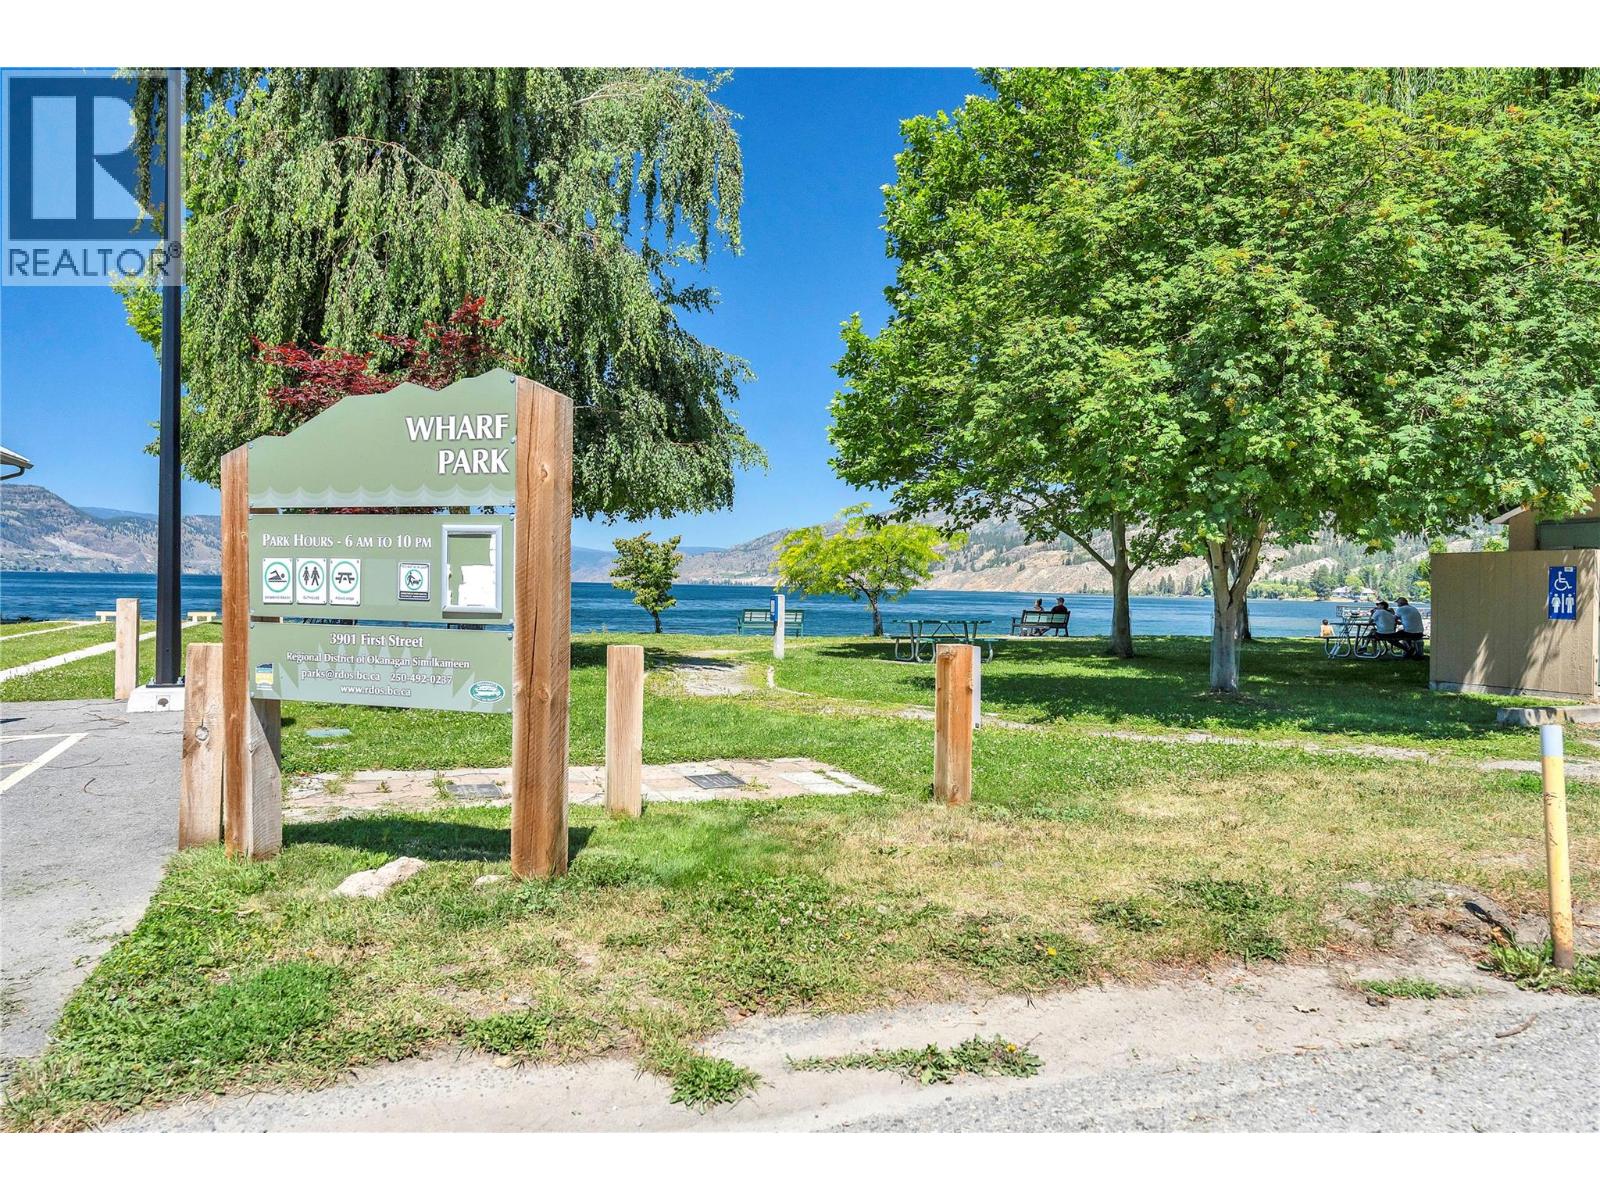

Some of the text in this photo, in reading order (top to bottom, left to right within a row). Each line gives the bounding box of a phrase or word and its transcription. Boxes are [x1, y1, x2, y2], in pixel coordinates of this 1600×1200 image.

[405, 414, 509, 441] WHARF
[438, 448, 510, 474] PARK
[345, 534, 353, 547] 6
[397, 534, 412, 548] 10
[329, 633, 424, 648] 3901 First Street
[286, 652, 470, 669] Regional District of Okanagan Similkameen
[301, 669, 381, 681] parks@rdos.bc.ca
[340, 684, 411, 697] www.rdos.bc.ca
